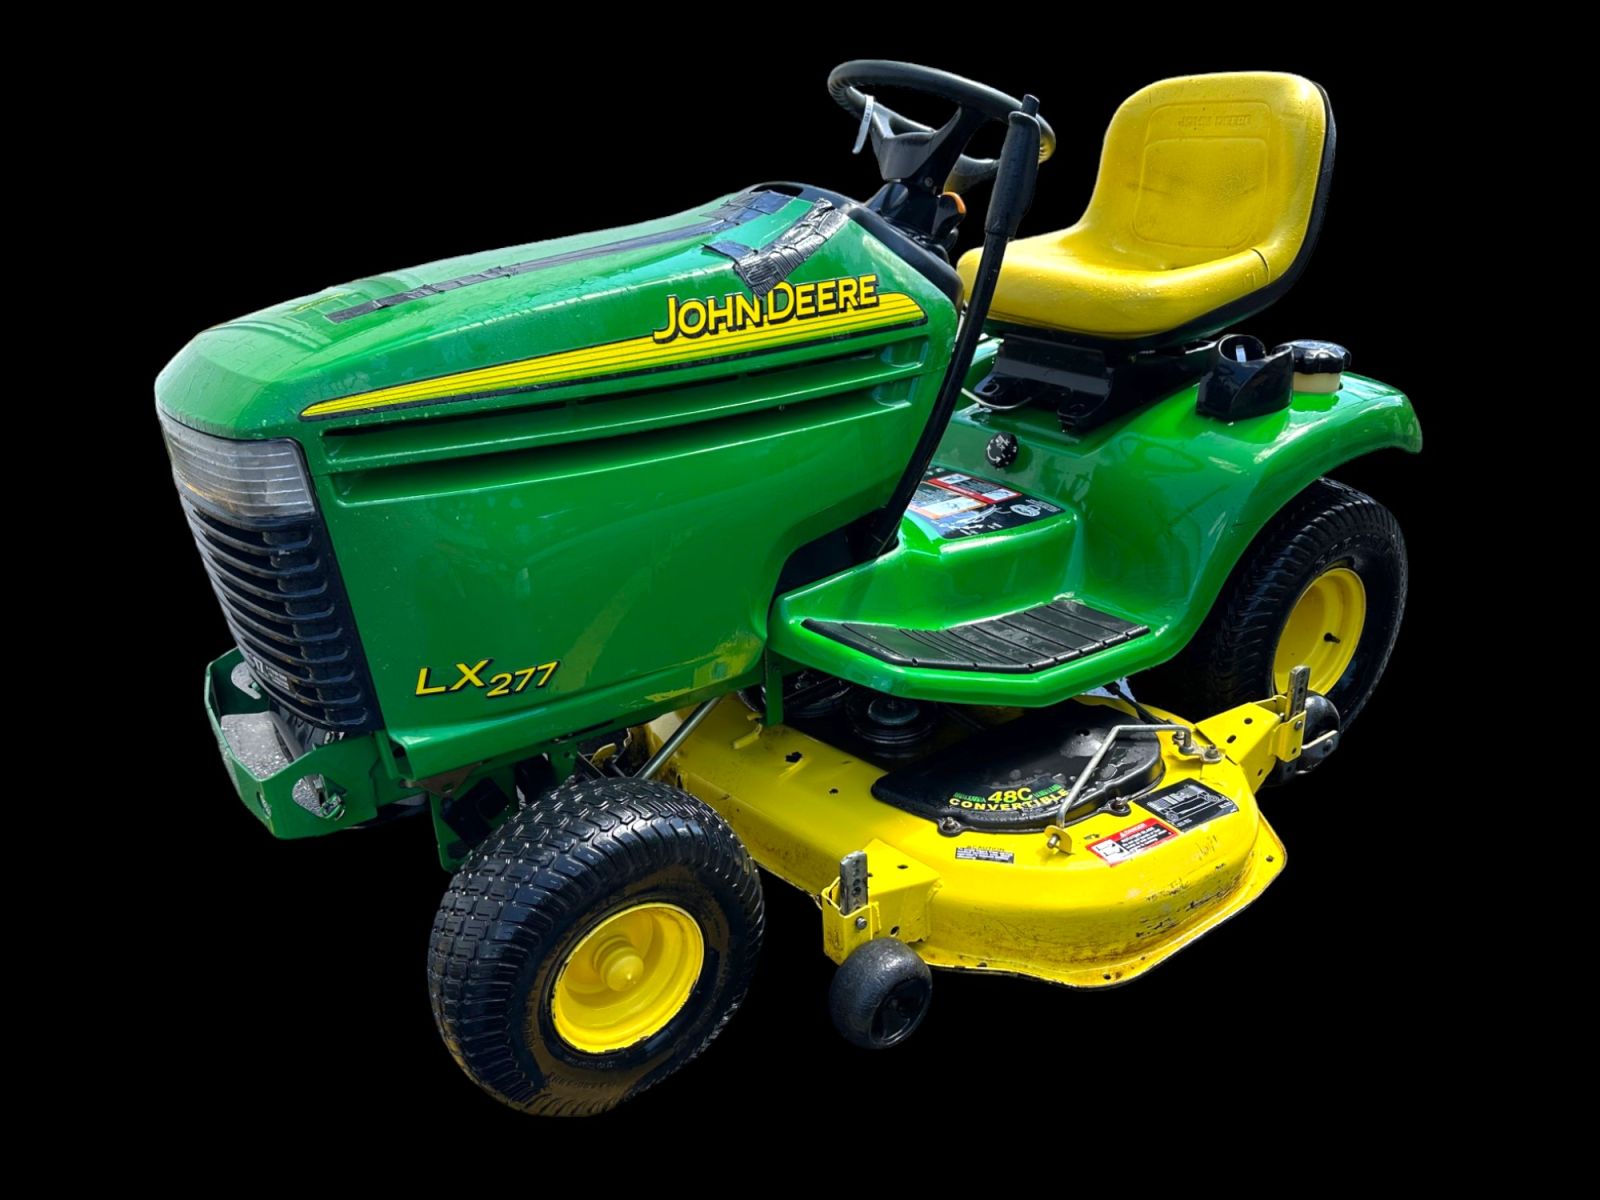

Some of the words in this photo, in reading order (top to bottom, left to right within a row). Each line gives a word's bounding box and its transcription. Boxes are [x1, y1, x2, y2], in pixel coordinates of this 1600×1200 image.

[653, 294, 761, 343] JOHN
[767, 274, 879, 324] DEERE
[949, 788, 1069, 811] CONVERTIBLE
[988, 787, 1033, 804] 48C
